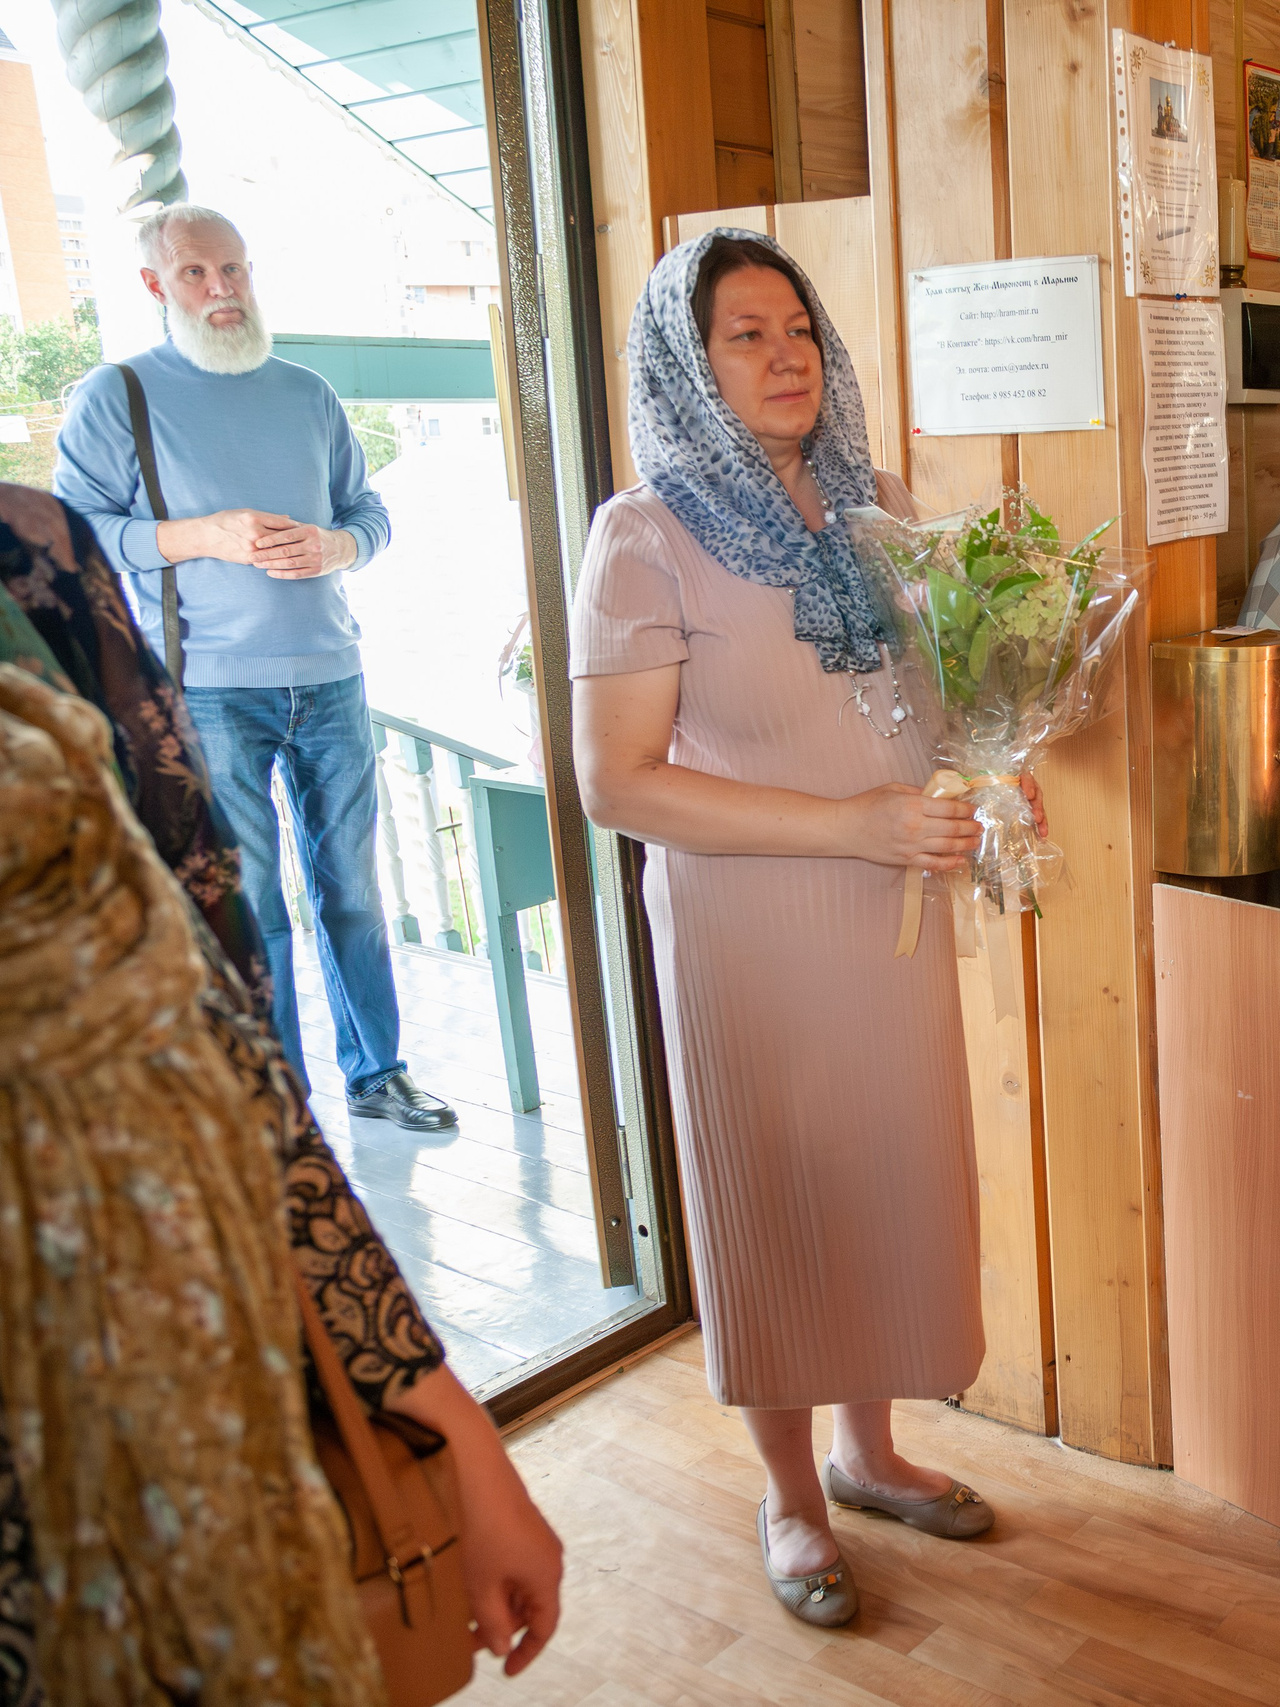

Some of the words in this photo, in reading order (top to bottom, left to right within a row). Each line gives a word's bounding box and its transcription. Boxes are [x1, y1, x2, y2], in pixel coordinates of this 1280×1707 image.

[925, 287, 943, 297] Храм
[945, 285, 971, 295] святых
[1041, 276, 1078, 287] Марьино
[959, 309, 979, 321] Сайт:
[980, 306, 1039, 320] http://hram-mir.ru
[985, 332, 1068, 347] https://vk.com/hram_mir
[968, 366, 990, 374] почта:
[960, 391, 991, 402] Телефон:
[993, 391, 997, 399] 8
[998, 390, 1012, 399] 985
[1013, 389, 1026, 398] 452
[1027, 389, 1036, 397] 08
[1037, 388, 1047, 397] 82
